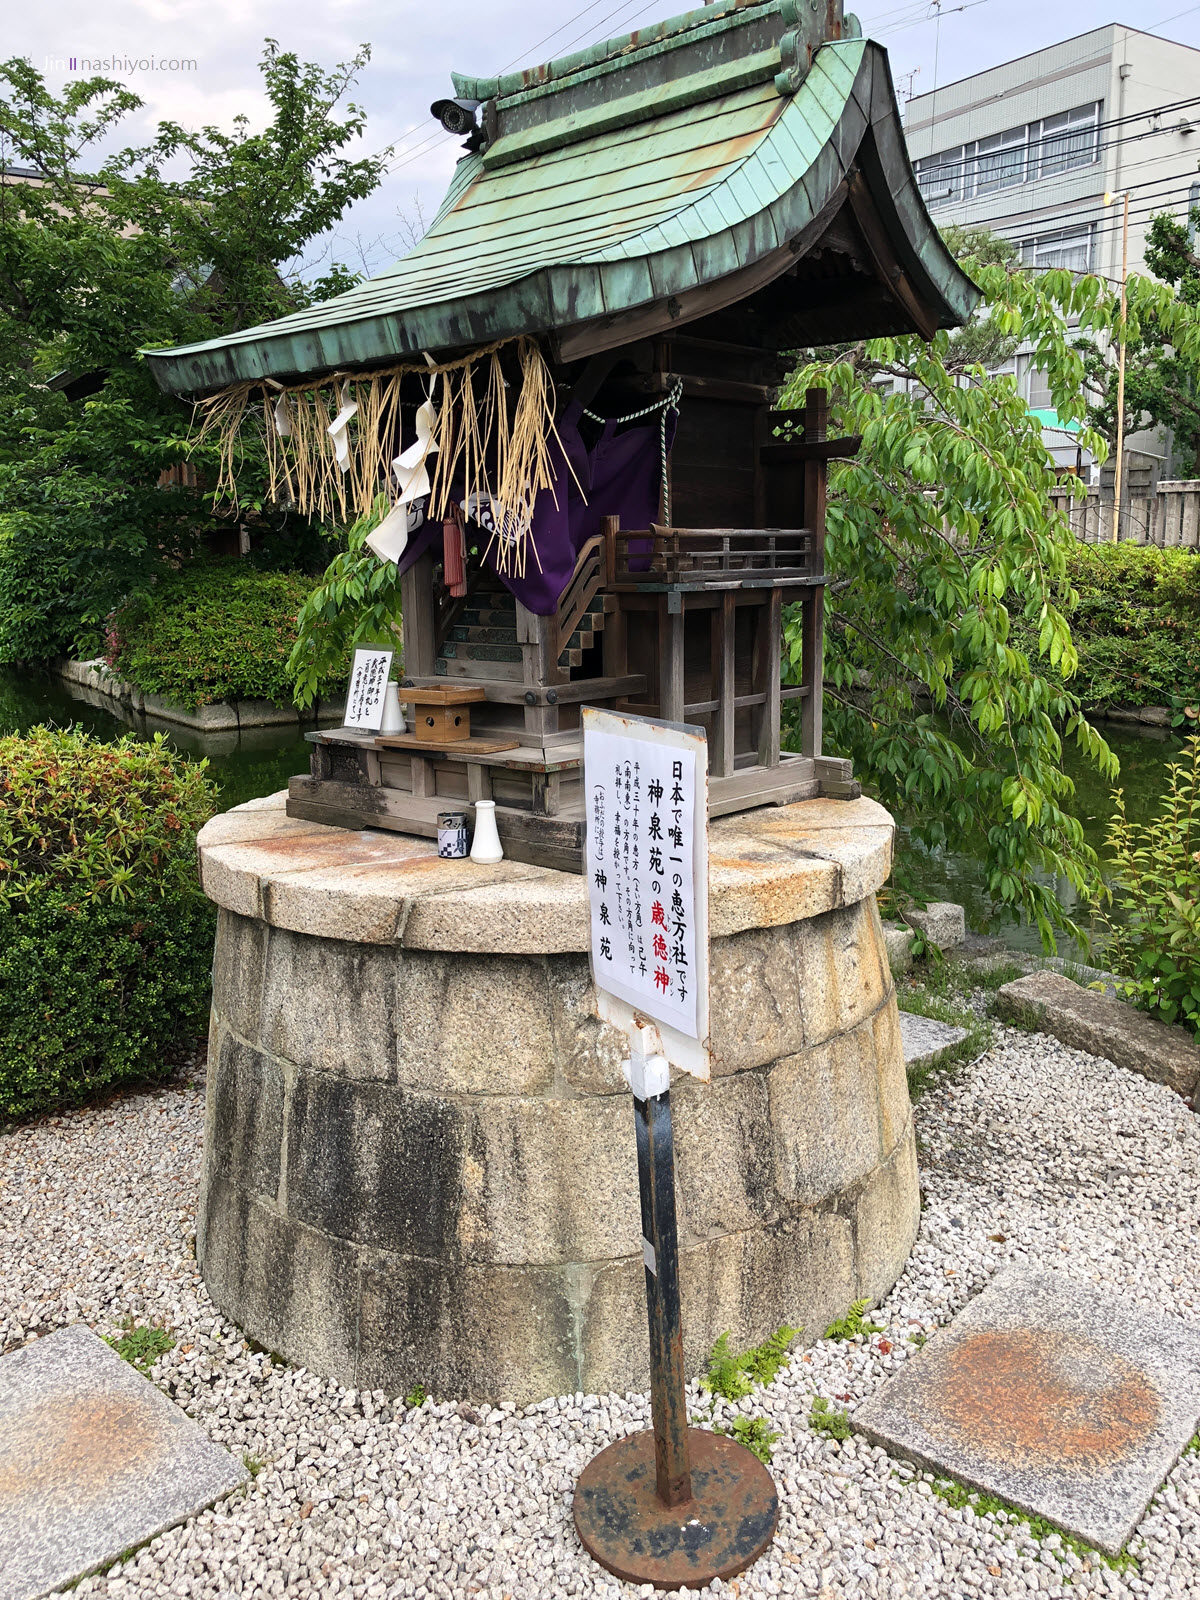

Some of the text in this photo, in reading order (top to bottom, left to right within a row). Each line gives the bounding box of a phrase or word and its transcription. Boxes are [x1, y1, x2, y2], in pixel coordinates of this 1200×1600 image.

[594, 868, 612, 961] 神泉苑
[647, 778, 670, 995] 神泉苑の歳徳神
[667, 760, 688, 1003] 日本で唯一の恵方社です
